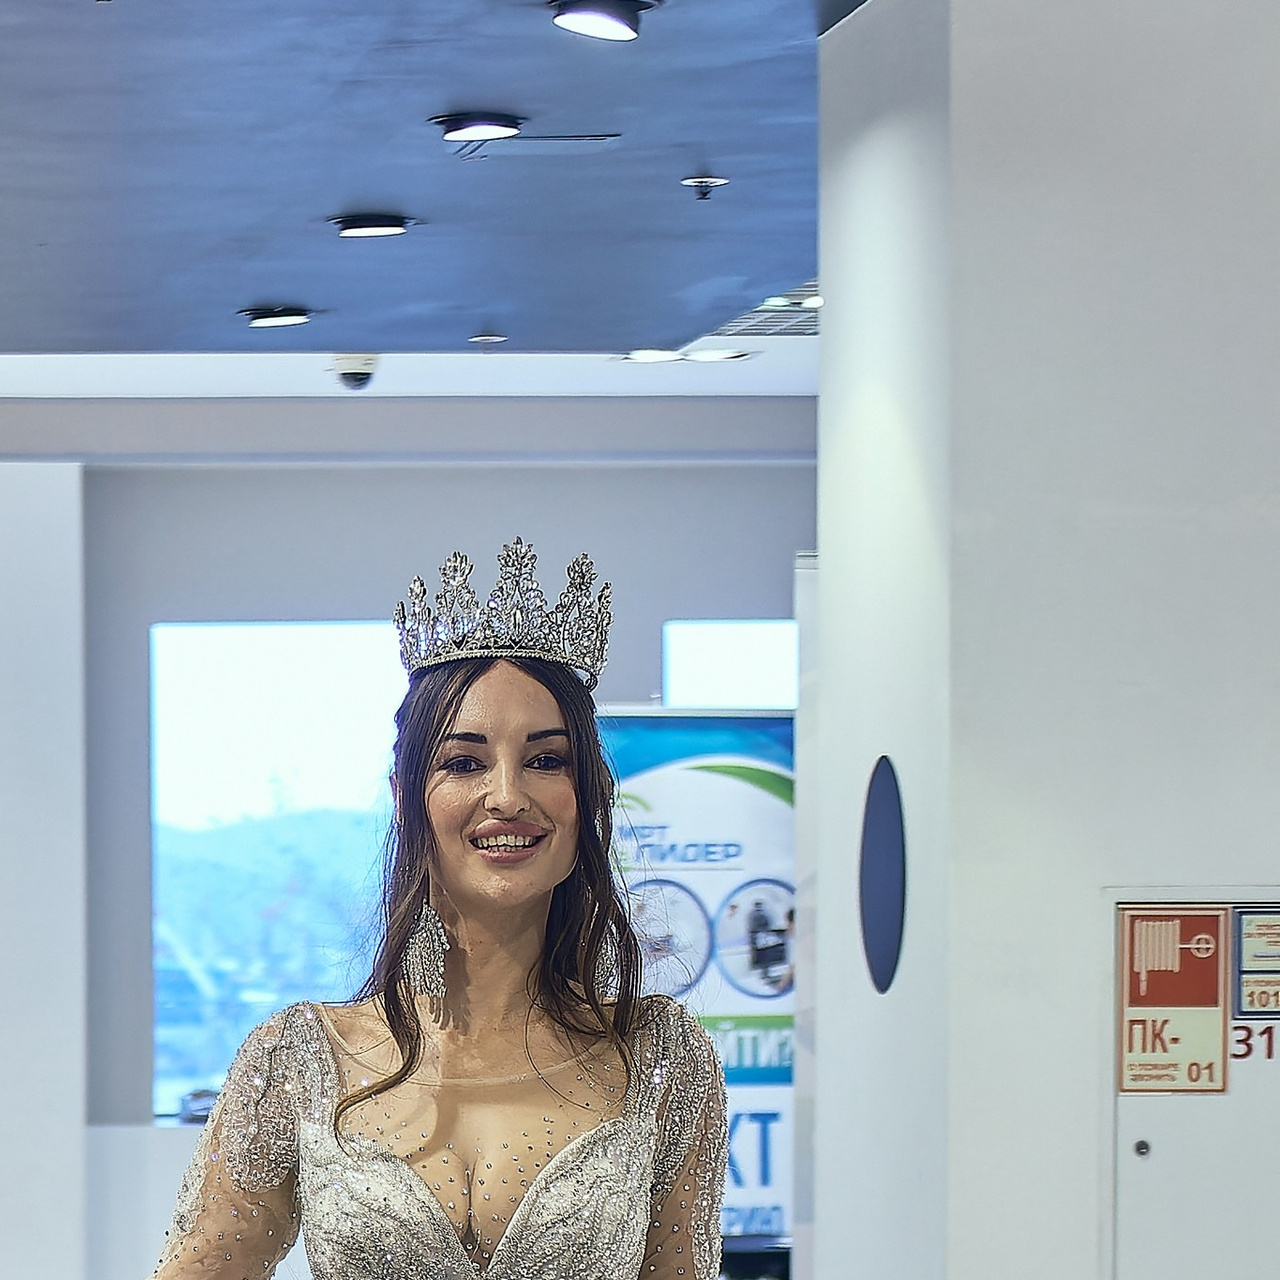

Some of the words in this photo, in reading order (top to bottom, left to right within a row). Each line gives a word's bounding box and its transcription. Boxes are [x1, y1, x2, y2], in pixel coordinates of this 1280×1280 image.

[1127, 1019, 1181, 1053] ПК-
[1230, 1025, 1276, 1060] 31
[1187, 1062, 1214, 1083] 01
